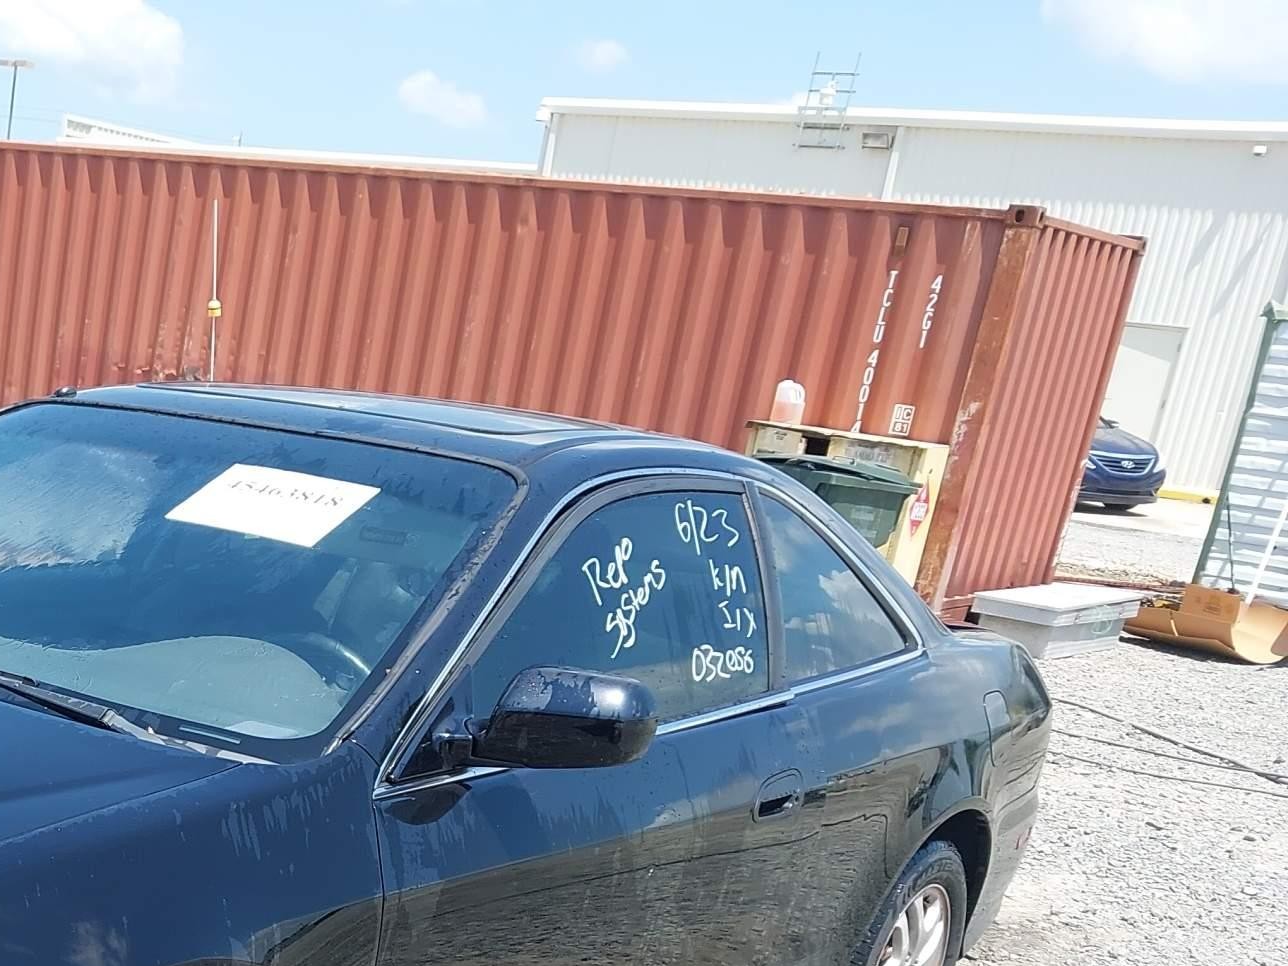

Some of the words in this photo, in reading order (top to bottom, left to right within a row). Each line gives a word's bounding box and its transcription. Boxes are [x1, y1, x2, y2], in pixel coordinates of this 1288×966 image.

[873, 270, 899, 343] TCLU
[919, 275, 944, 349] 42G1
[675, 500, 740, 555] 6/23
